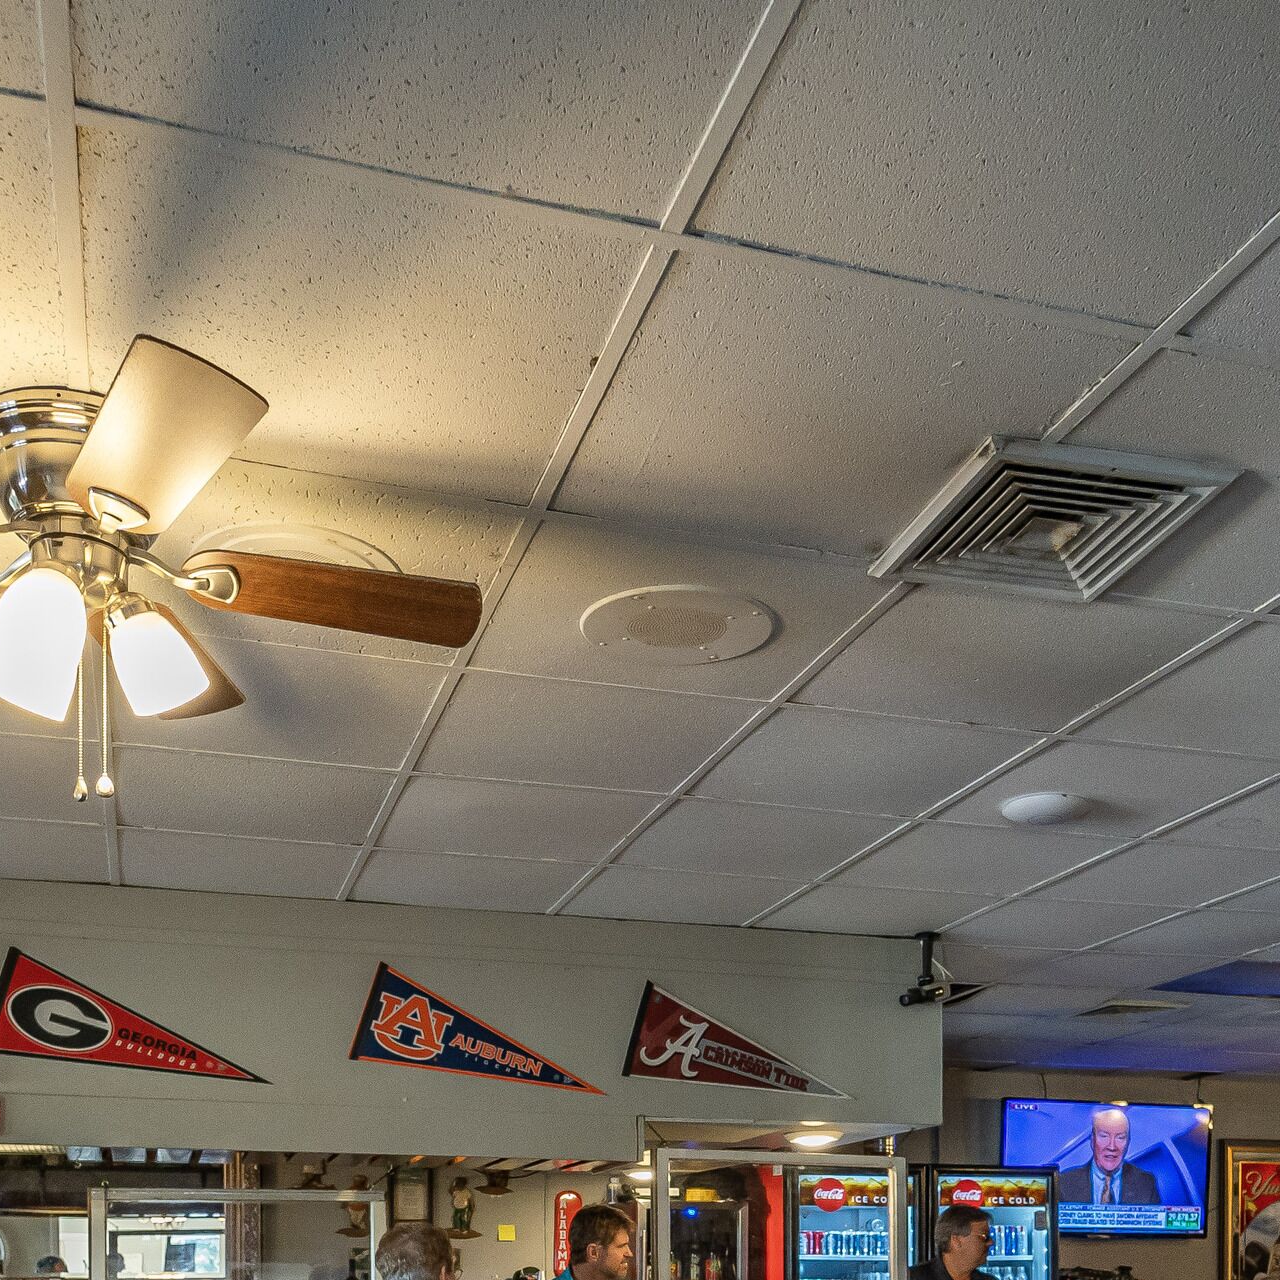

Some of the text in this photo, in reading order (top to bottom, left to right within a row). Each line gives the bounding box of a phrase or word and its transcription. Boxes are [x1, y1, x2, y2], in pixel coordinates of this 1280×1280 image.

[10, 987, 110, 1049] G
[115, 1039, 197, 1070] BULLDOGS
[117, 1027, 199, 1061] GEORGIA
[448, 1032, 543, 1077] AUBURN
[1014, 1103, 1035, 1111] LIVE
[851, 1195, 888, 1204] ICE CO
[988, 1196, 1036, 1205] ICE COLD
[557, 1199, 568, 1271] ALABAMA
